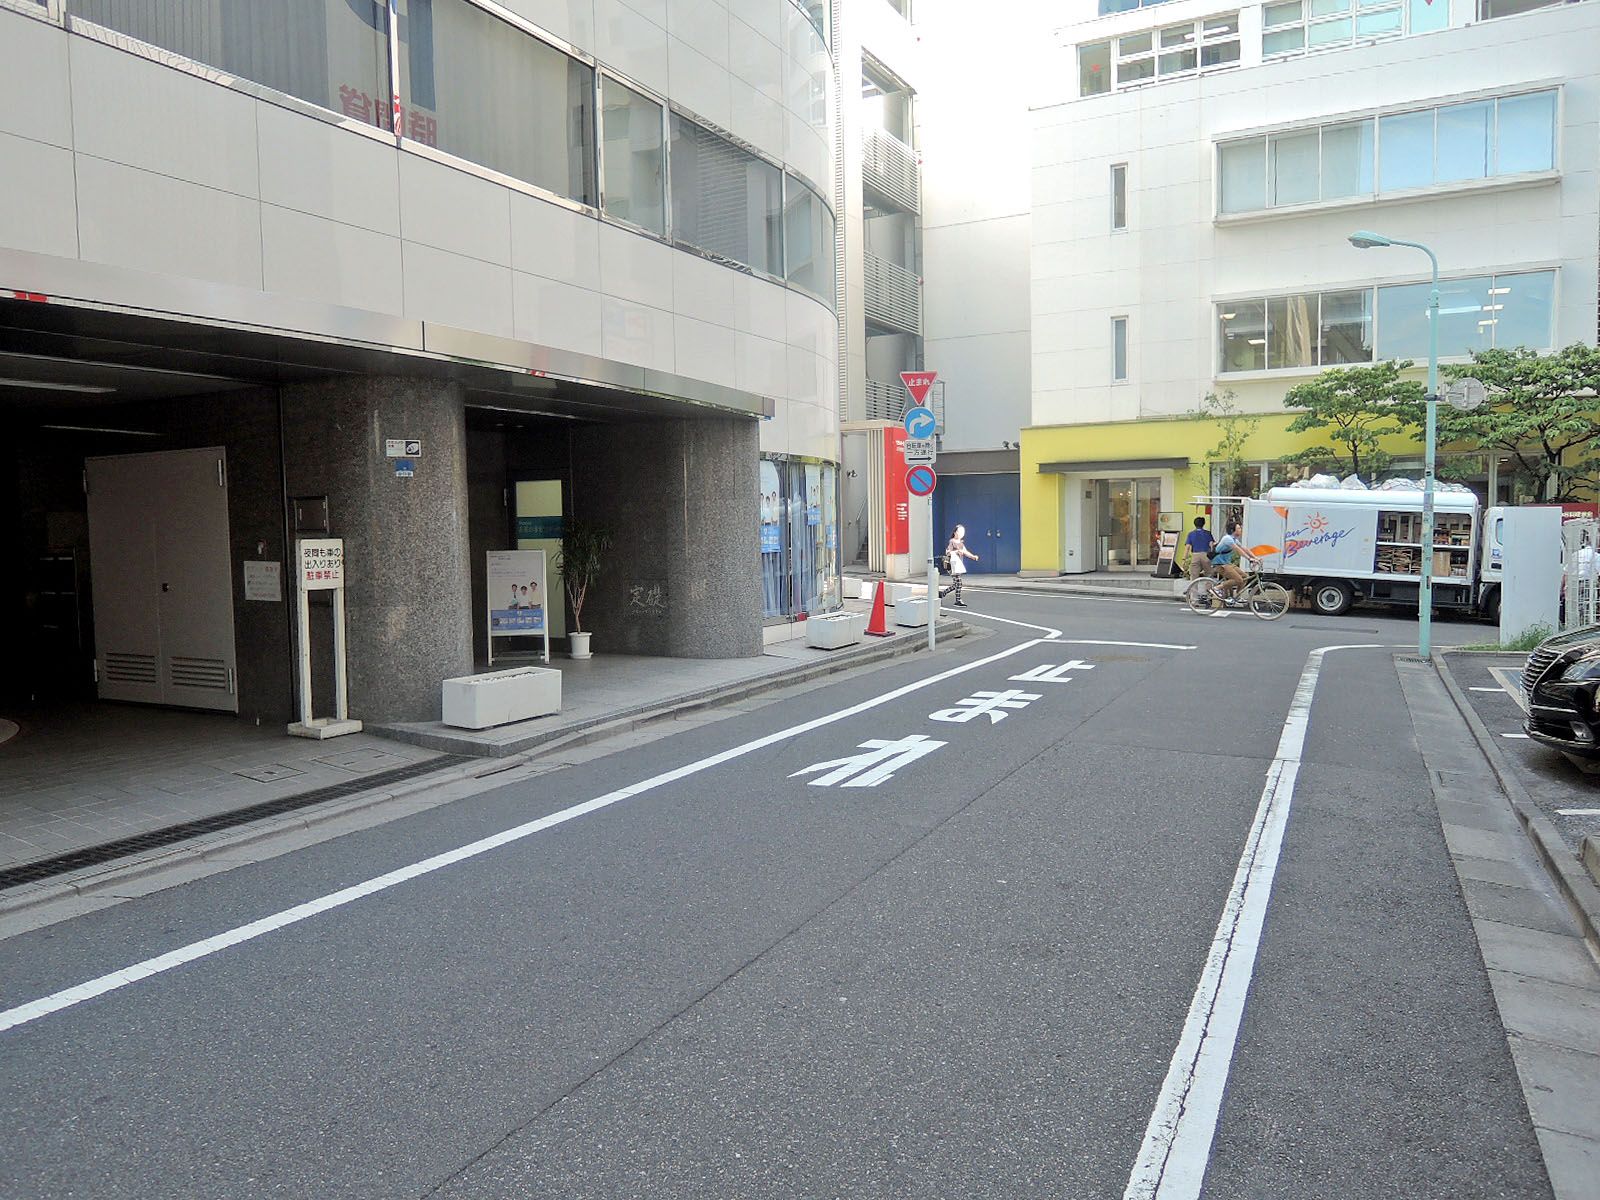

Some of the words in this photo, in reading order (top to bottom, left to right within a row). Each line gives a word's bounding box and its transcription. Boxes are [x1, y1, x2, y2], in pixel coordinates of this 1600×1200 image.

[908, 378, 930, 387] 止まれ
[1283, 527, 1355, 558] Beverage
[304, 548, 341, 558] 夜間も車の
[304, 559, 341, 570] 出入りあり
[306, 570, 339, 580] 駐車禁止
[786, 659, 1096, 788] 止まれ
